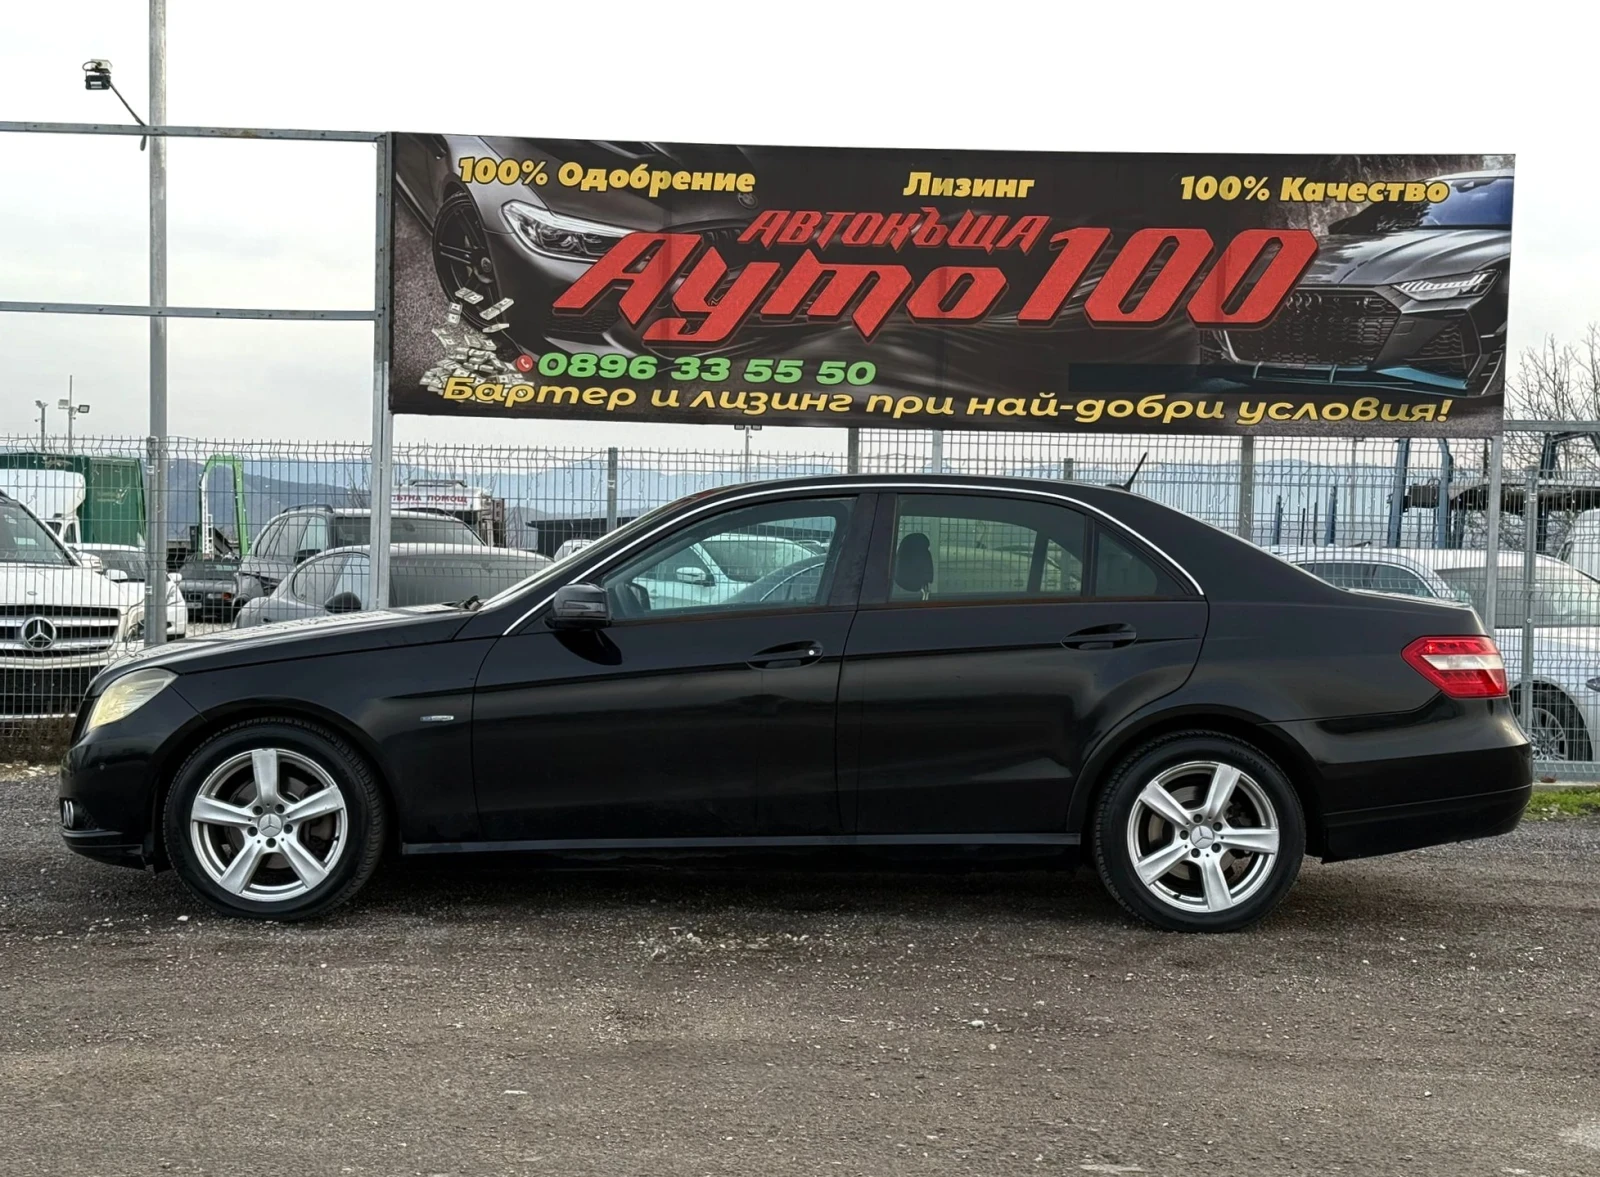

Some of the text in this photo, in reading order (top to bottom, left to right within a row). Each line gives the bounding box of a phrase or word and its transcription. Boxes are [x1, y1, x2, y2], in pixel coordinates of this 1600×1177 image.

[459, 157, 756, 198] 100% Одобрение
[902, 171, 1035, 198] Лизинг
[1180, 175, 1449, 203] 100% Качество
[739, 206, 1049, 252] АВТОКЪЩА
[553, 226, 1318, 342] Ауто 100
[538, 352, 876, 384] 0896 33 55 50
[443, 376, 1453, 425] Бартер и лизинг при най-добри условия!
